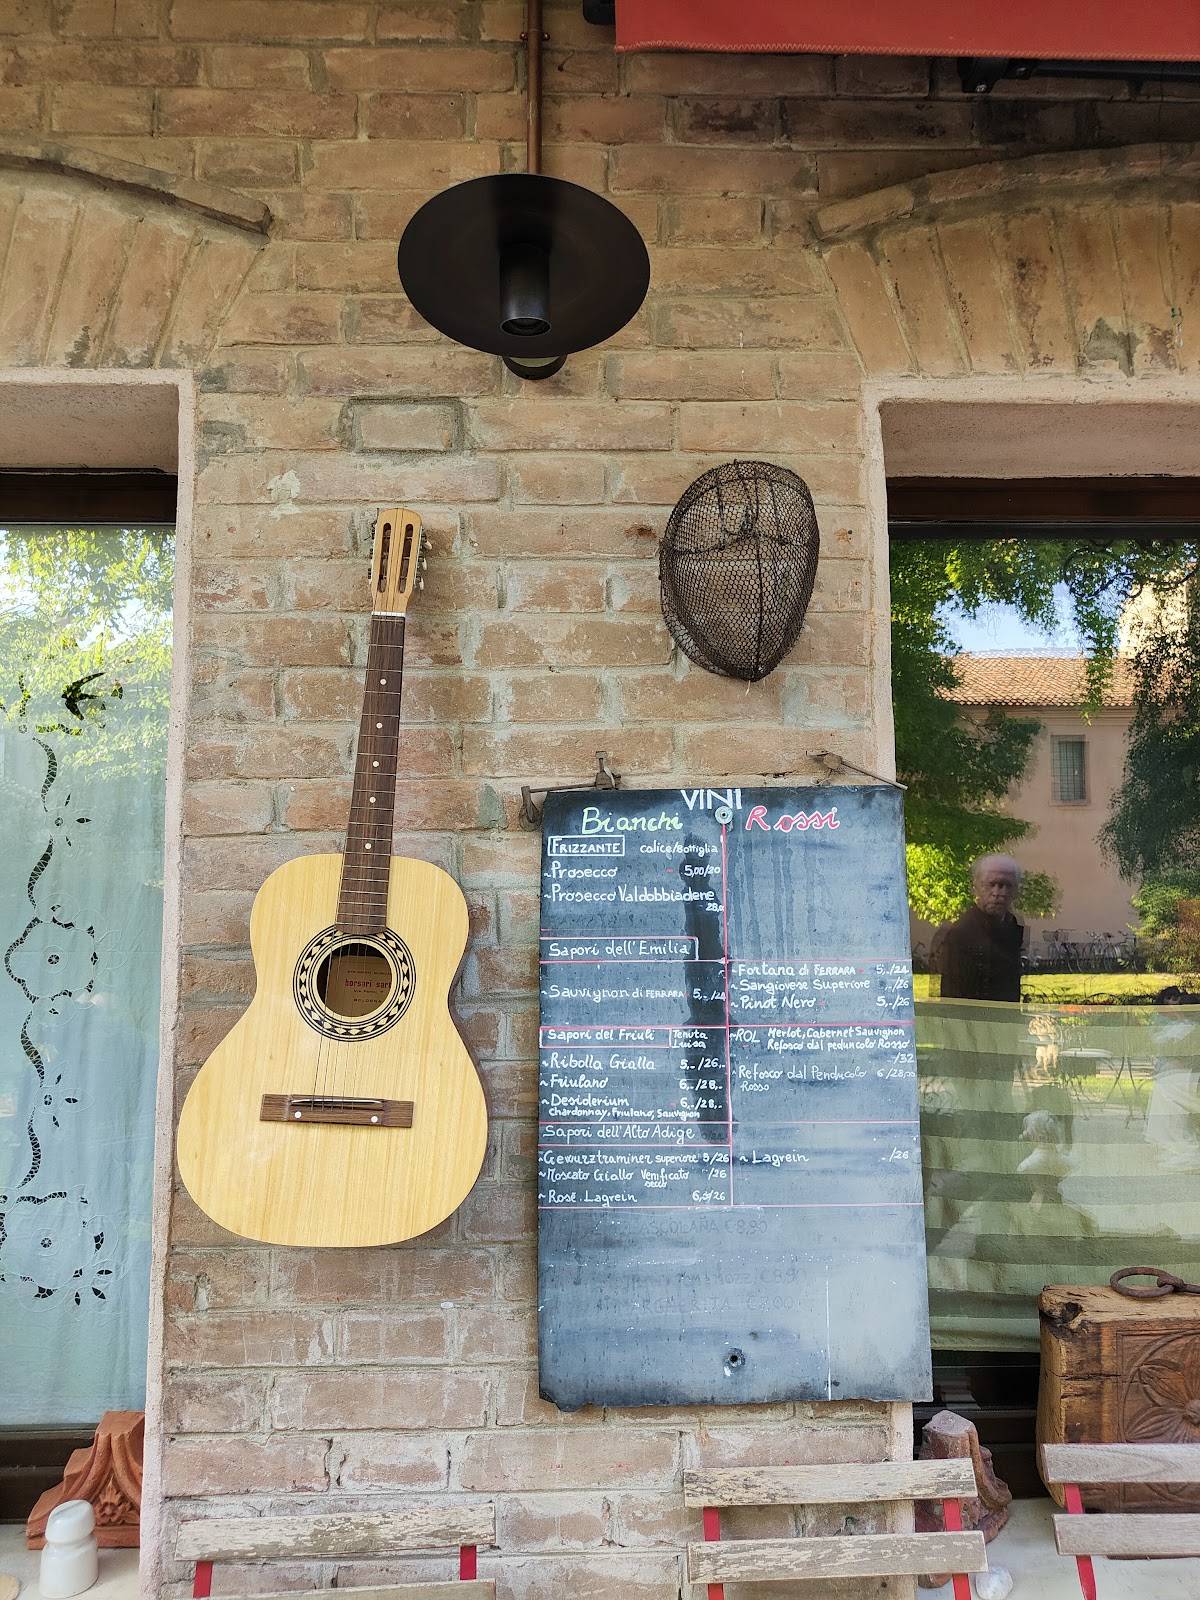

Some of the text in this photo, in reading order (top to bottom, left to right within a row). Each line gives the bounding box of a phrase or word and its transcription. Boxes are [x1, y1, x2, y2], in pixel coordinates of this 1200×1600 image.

[681, 789, 742, 810] VINI
[582, 807, 683, 834] Bianchi
[745, 805, 840, 832] Rossi
[552, 838, 621, 853] FRIZZANTE
[551, 861, 619, 878] Prosecco
[552, 884, 715, 902] Prosecco Valdobbiadene
[549, 943, 599, 959] Sapori
[639, 940, 690, 955] Emilia
[738, 962, 795, 976] Fortana
[799, 964, 809, 975] di
[814, 965, 856, 975] FERRARA
[549, 985, 629, 1003] Sauvignon
[632, 988, 643, 998] di
[646, 990, 684, 998] FERRARA
[739, 979, 808, 994] Sangiovese
[813, 979, 871, 992] Superiore
[740, 995, 776, 1009] Pinot
[781, 997, 816, 1009] Nero
[547, 1028, 655, 1043] Sapori del Friuli
[673, 1029, 708, 1040] Tenuta
[735, 1030, 760, 1043] ROL
[855, 1027, 905, 1040] Sauvignon
[672, 1039, 706, 1049] Luisa
[767, 1039, 803, 1054] Refosco
[807, 1039, 824, 1050] dal
[877, 1040, 910, 1049] Rosso
[550, 1052, 603, 1070] Ribolla
[609, 1054, 656, 1070] Gialla
[738, 1064, 784, 1080] Refosco
[787, 1065, 807, 1079] dal
[550, 1074, 608, 1088] Friulano
[740, 1080, 769, 1092] Rosso
[551, 1093, 629, 1107] Desiderium
[543, 1125, 592, 1144] Sapori
[623, 1126, 649, 1138] Alto
[651, 1126, 695, 1144] Adige
[544, 1150, 653, 1165] Gewurztraminer
[752, 1150, 809, 1167] Lagrein
[547, 1170, 590, 1182] Moscato
[594, 1170, 634, 1181] Giallo
[584, 1191, 637, 1207] Lagrein
